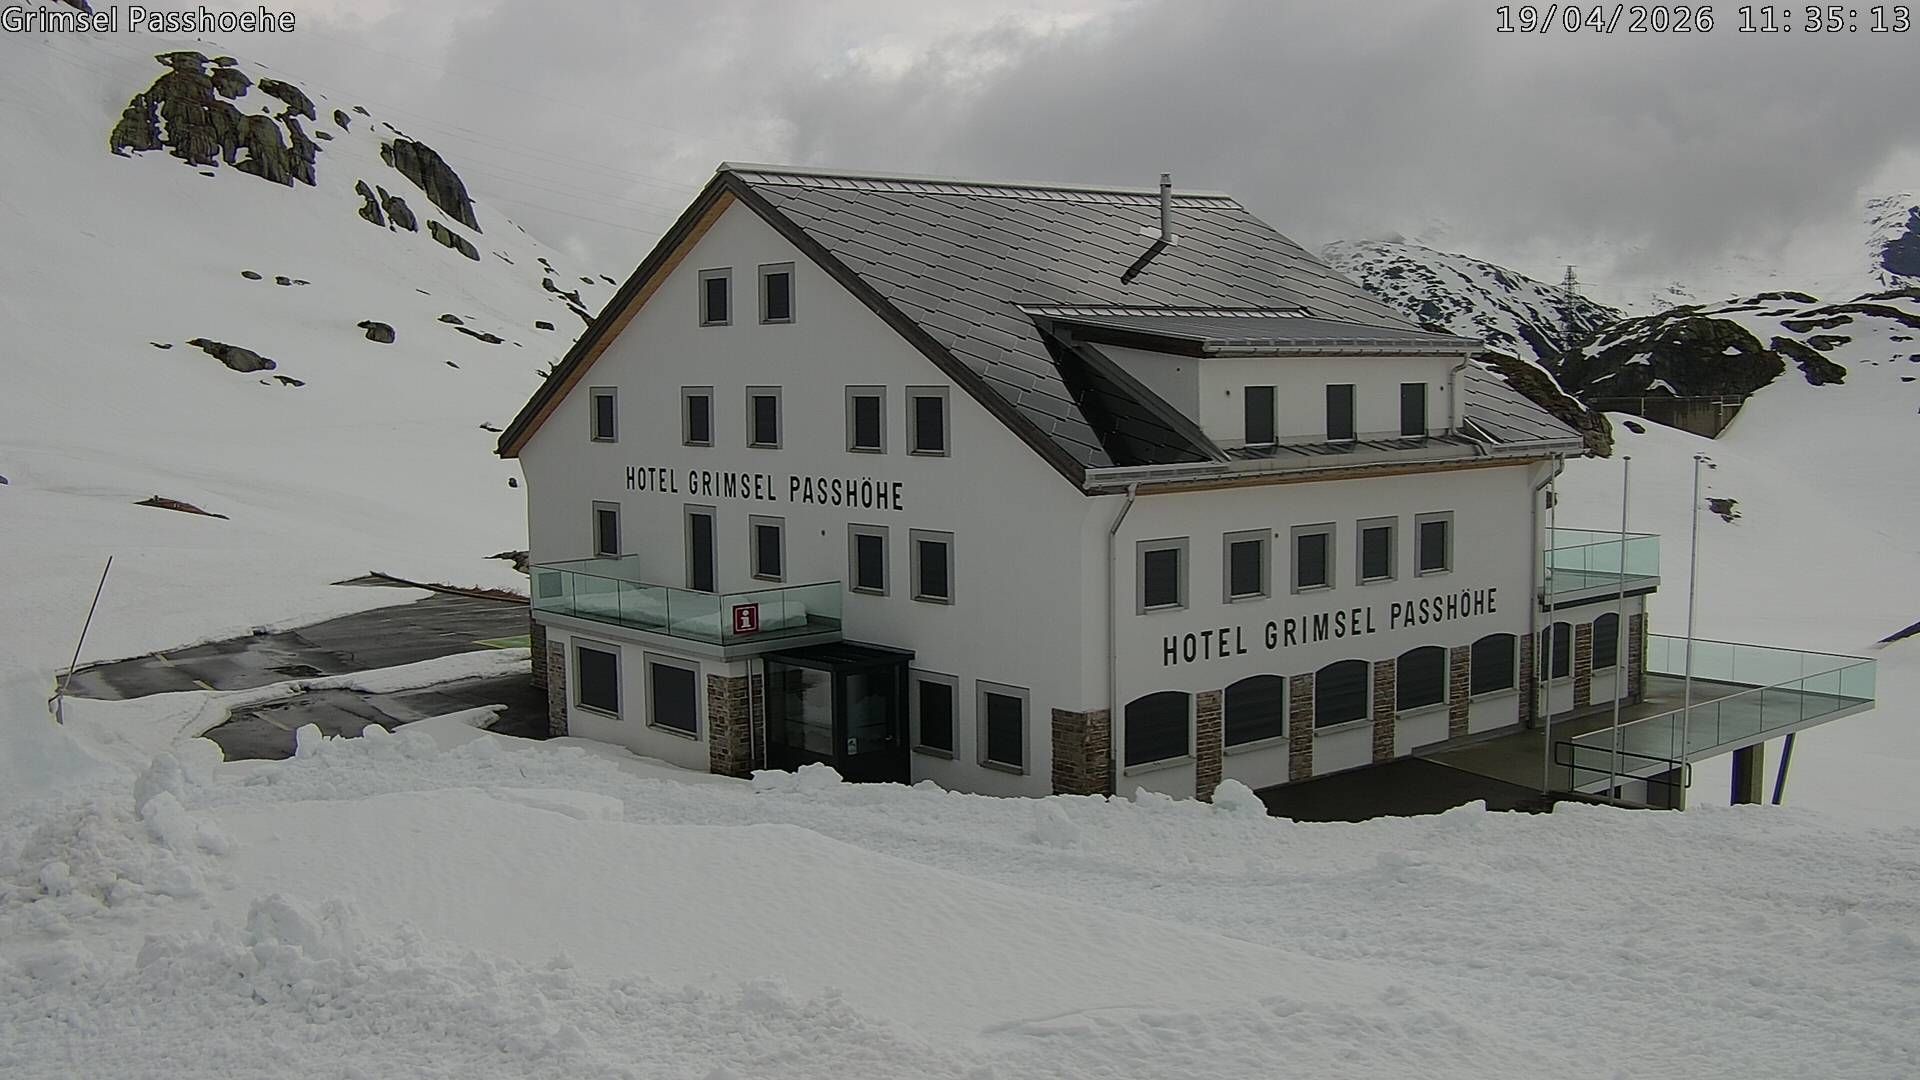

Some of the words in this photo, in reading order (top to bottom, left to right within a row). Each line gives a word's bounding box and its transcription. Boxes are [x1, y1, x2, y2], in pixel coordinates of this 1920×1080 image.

[625, 465, 679, 494] HOTEL
[688, 469, 777, 502] GRIMSEL
[789, 475, 904, 511] PASSHÖHE
[1163, 625, 1248, 667] HOTEL
[1264, 606, 1377, 650] GRIMSEL
[1390, 587, 1498, 631] PASSHÖHE
